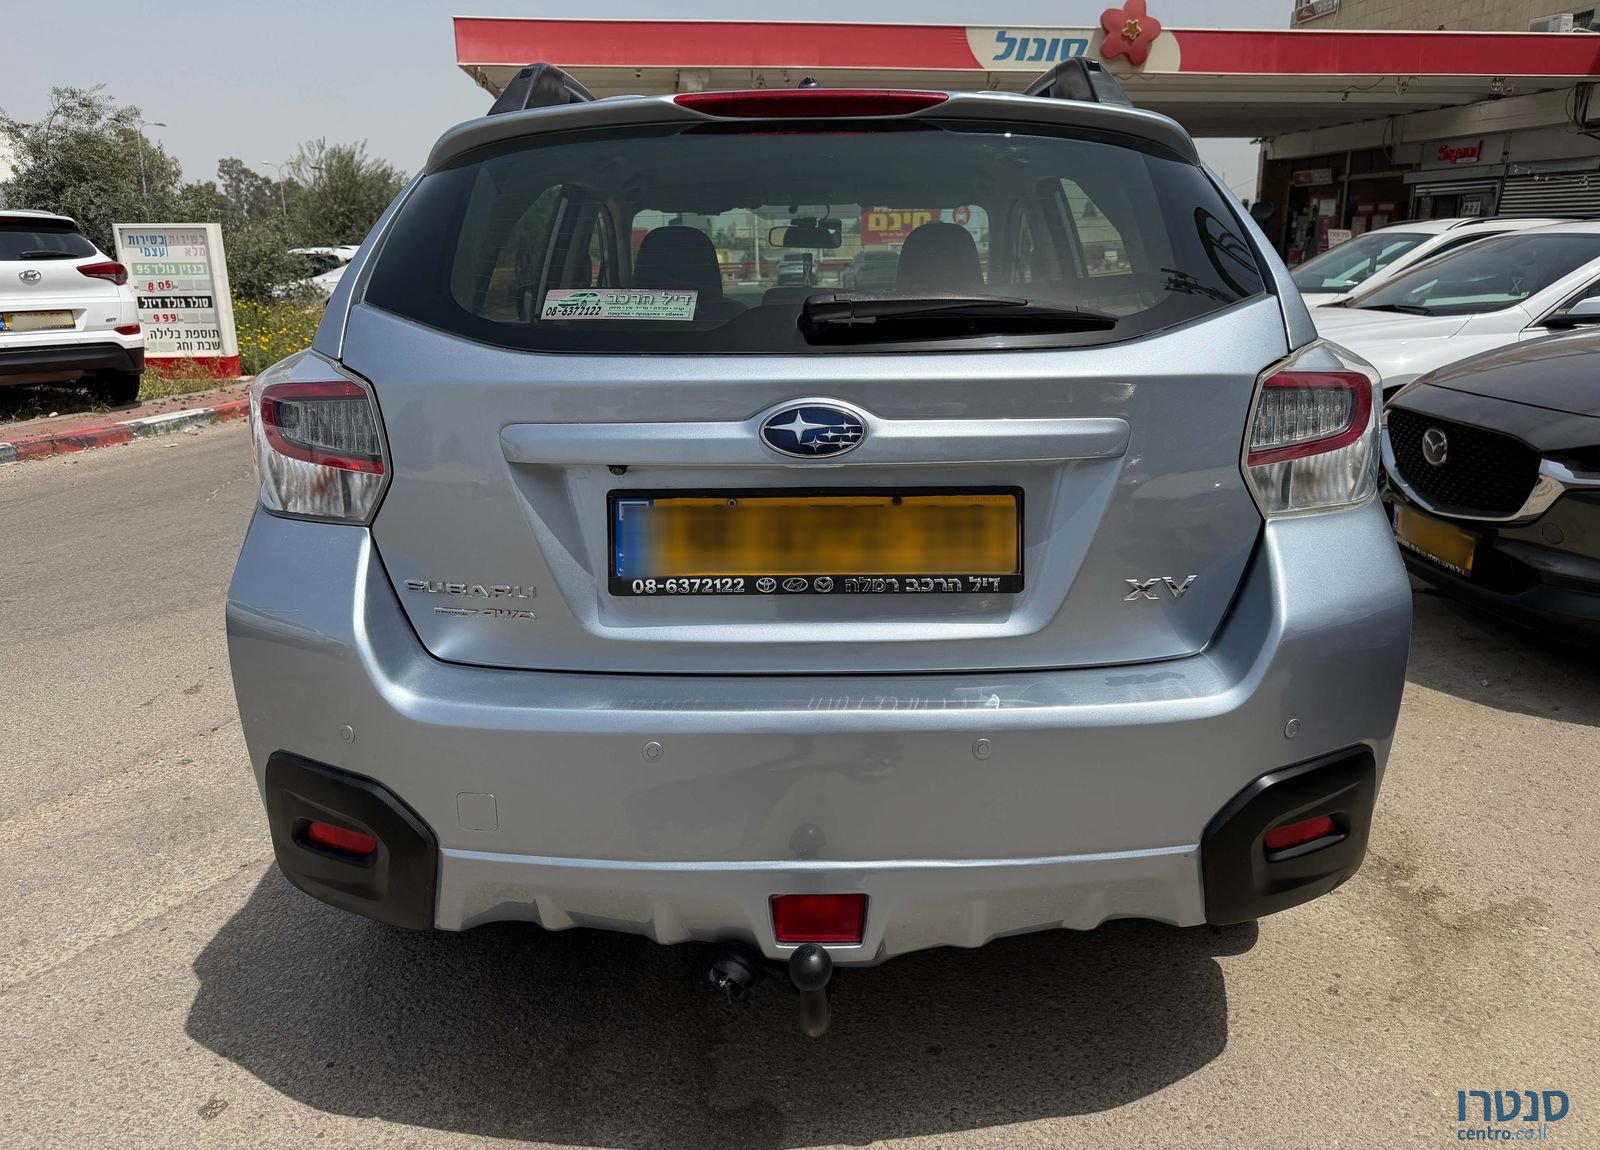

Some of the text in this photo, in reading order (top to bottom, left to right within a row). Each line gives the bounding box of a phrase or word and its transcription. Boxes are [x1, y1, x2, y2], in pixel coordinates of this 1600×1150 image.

[993, 30, 1089, 62] סונול
[867, 211, 932, 231] חינם
[128, 235, 165, 245] בשירות
[168, 235, 205, 245] בשירות
[140, 247, 165, 257] עצמי
[185, 247, 207, 257] מלא
[136, 264, 150, 274] 95
[179, 264, 204, 275] בנזין
[141, 297, 209, 309] סולר גולד דיזל
[605, 291, 691, 306] דיל הרכב
[545, 306, 602, 317] 08-6372122
[185, 329, 220, 339] תוספת
[176, 341, 221, 351] שבת וחג
[404, 579, 537, 599] SUBARU
[632, 577, 745, 594] 08-6372122
[844, 576, 1001, 592] דיל הרכב רמלה
[1123, 574, 1199, 601] XV
